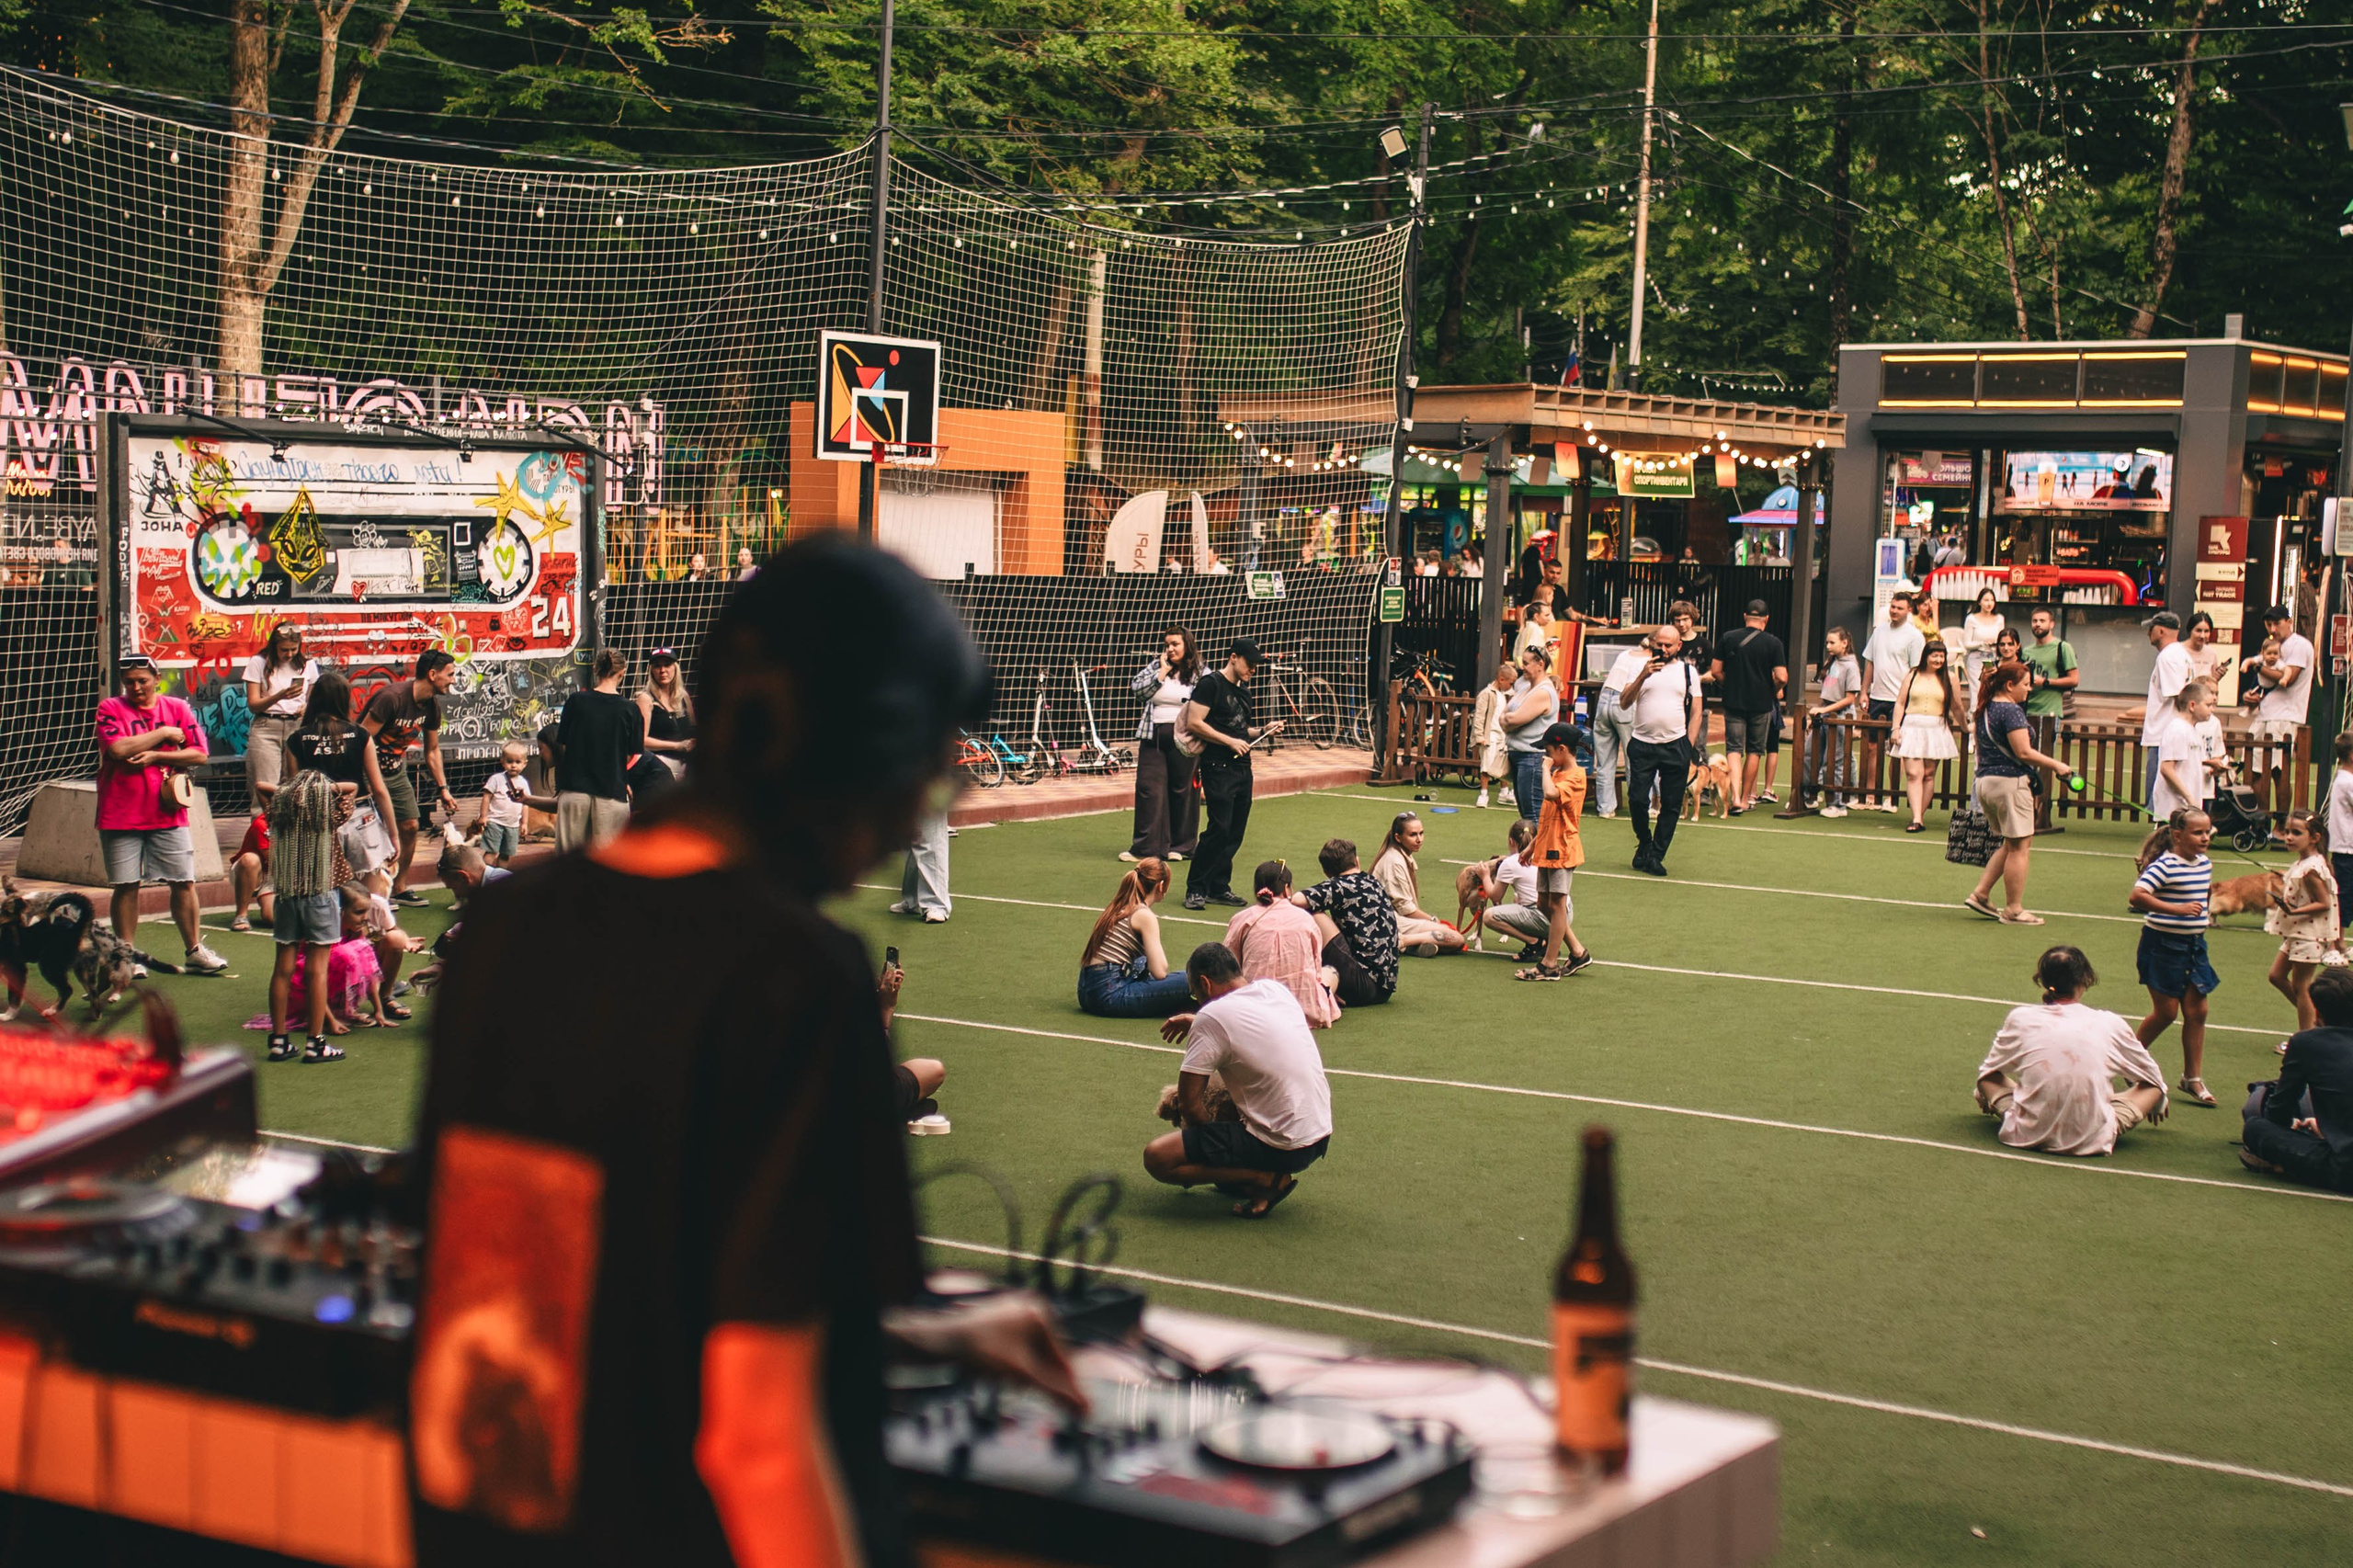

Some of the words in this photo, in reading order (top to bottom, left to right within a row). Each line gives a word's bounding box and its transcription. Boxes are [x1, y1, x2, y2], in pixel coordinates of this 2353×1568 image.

[404, 426, 462, 438] ВЧАТЛЕНИЯ
[1633, 474, 1688, 487] СПОРТИНВЕНТАРЯ
[141, 520, 184, 532] ЗОНА
[1132, 533, 1149, 573] УРЫ
[256, 581, 279, 596] RED
[530, 596, 572, 638] 24
[185, 649, 233, 695] UFO
[322, 732, 356, 742] LOING
